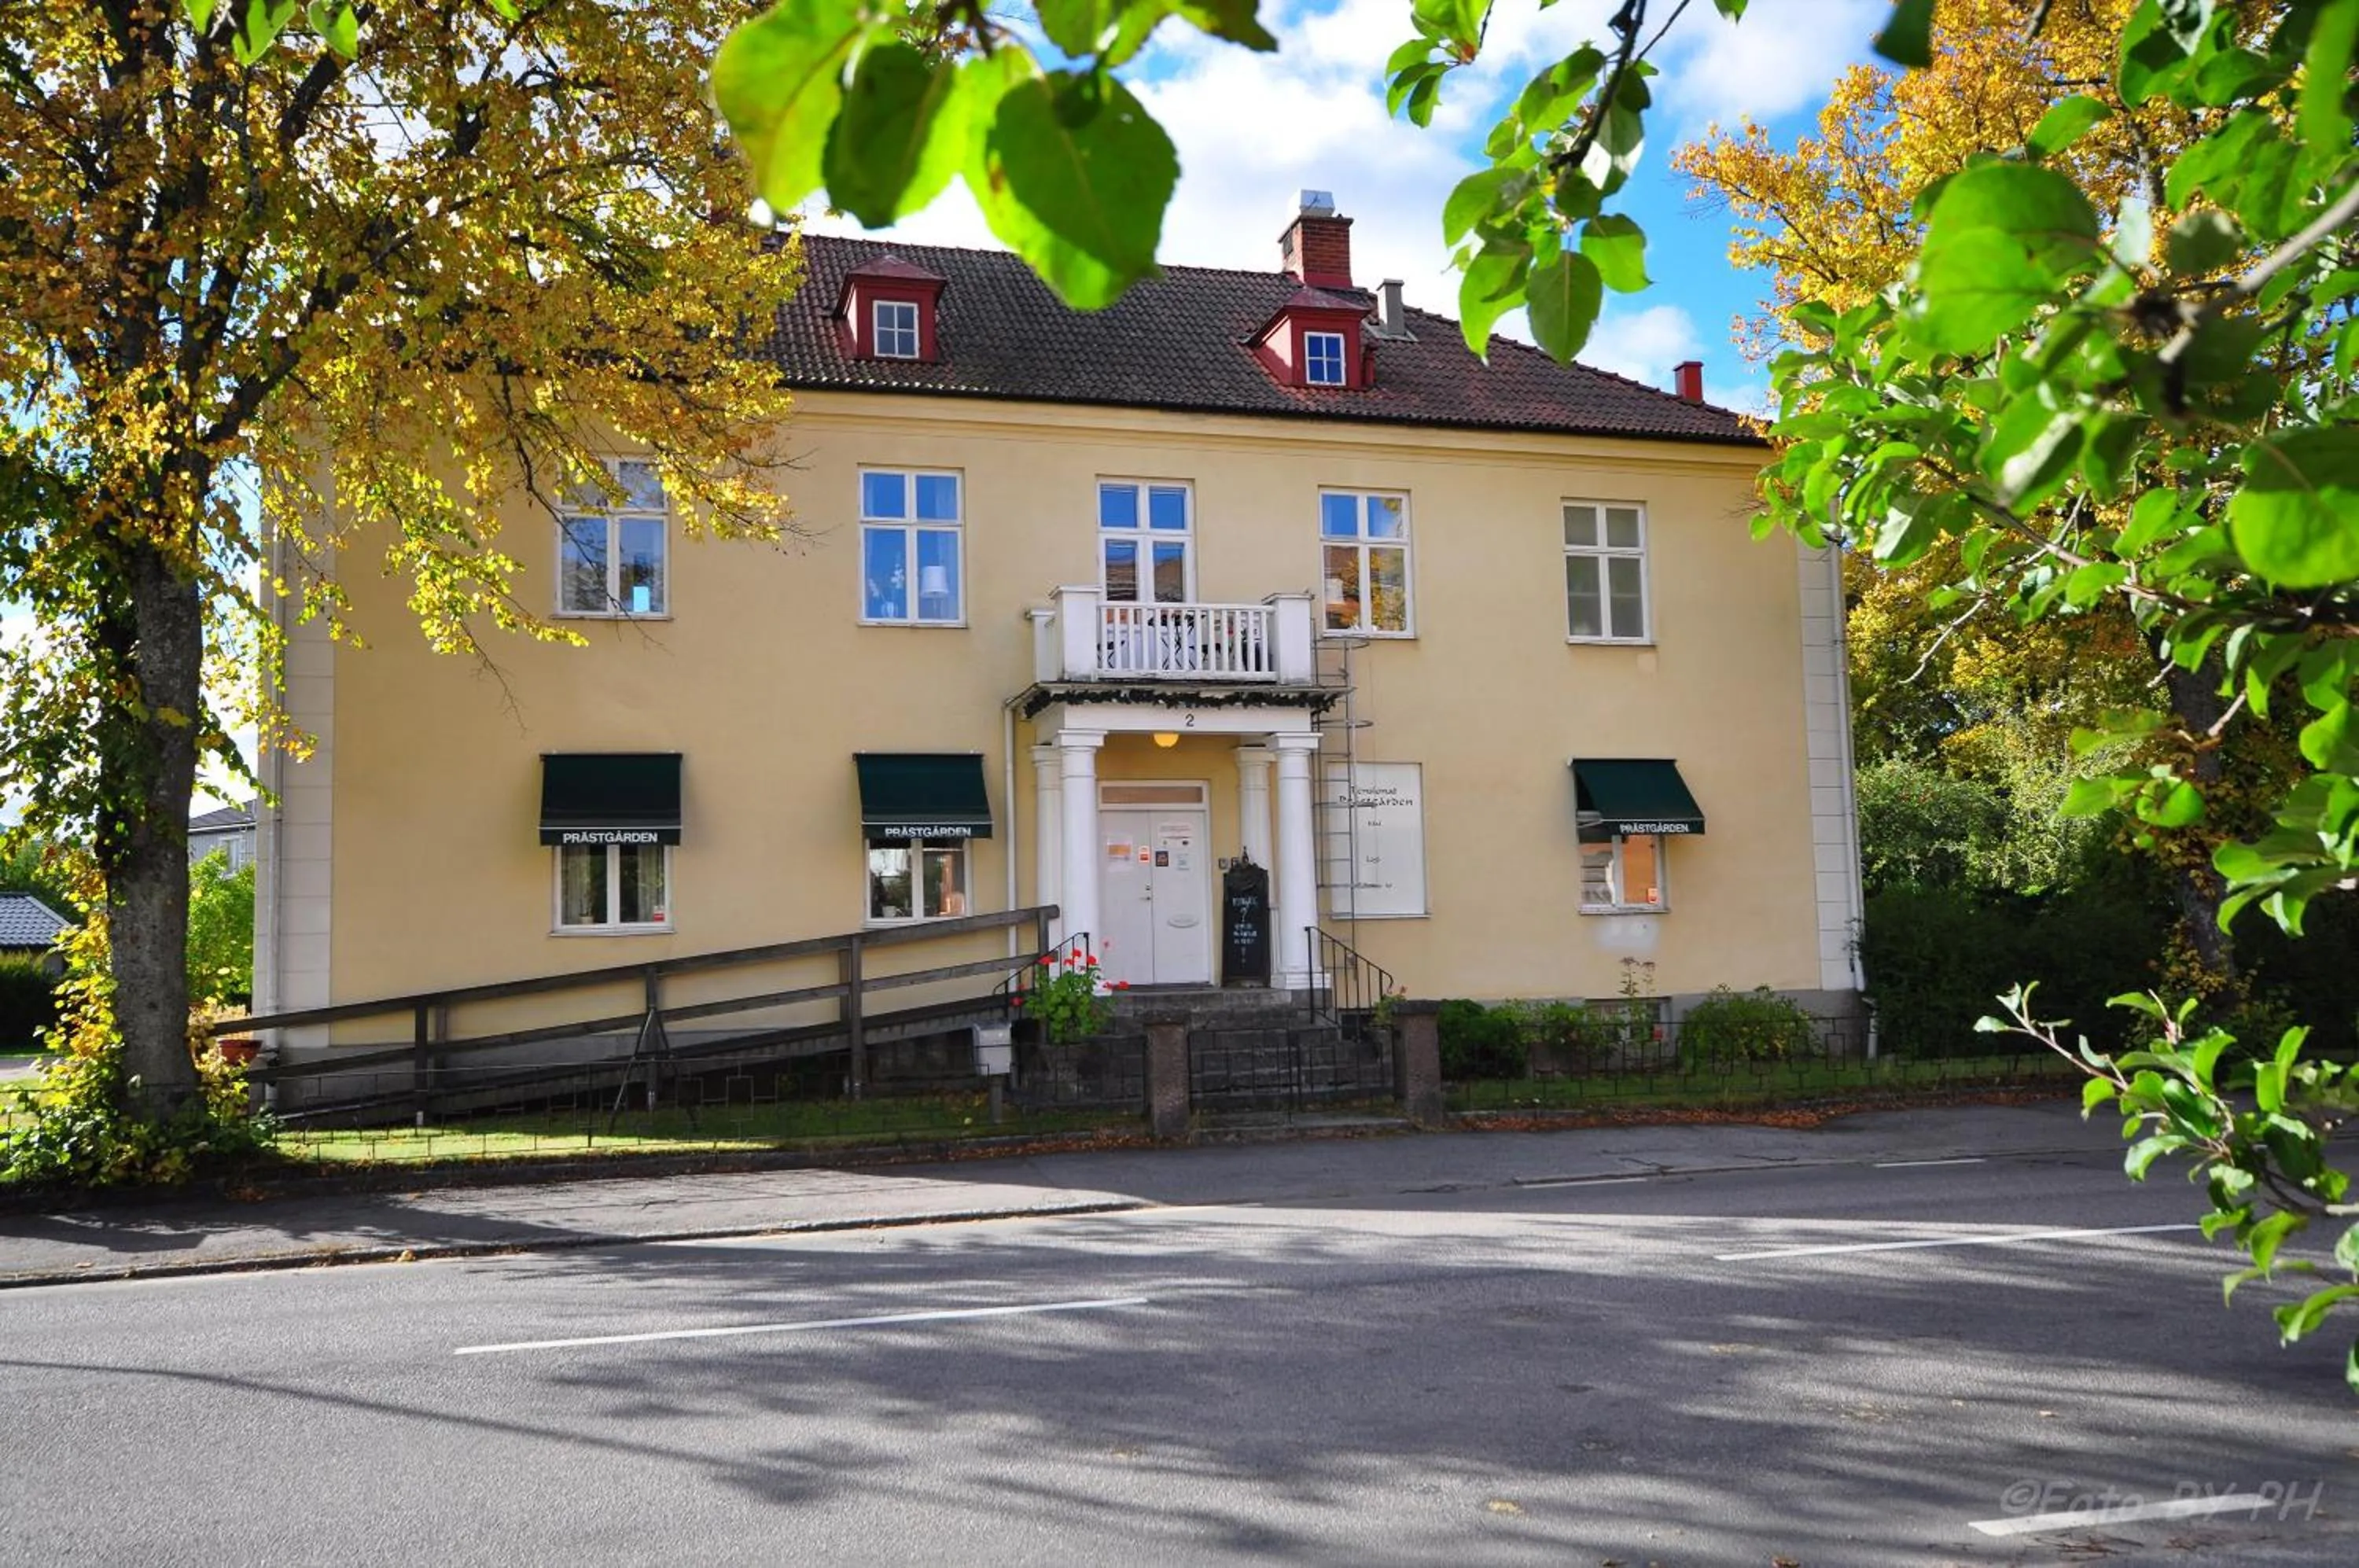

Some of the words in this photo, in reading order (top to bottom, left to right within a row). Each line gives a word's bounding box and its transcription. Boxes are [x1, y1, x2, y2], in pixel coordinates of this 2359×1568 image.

[1185, 713, 1194, 727] 2
[885, 826, 971, 837] PRÄSTGÅRDEN
[1620, 823, 1688, 833] PRÄSTGÅRDEN
[562, 830, 658, 844] PRÄSTGÅRDEN
